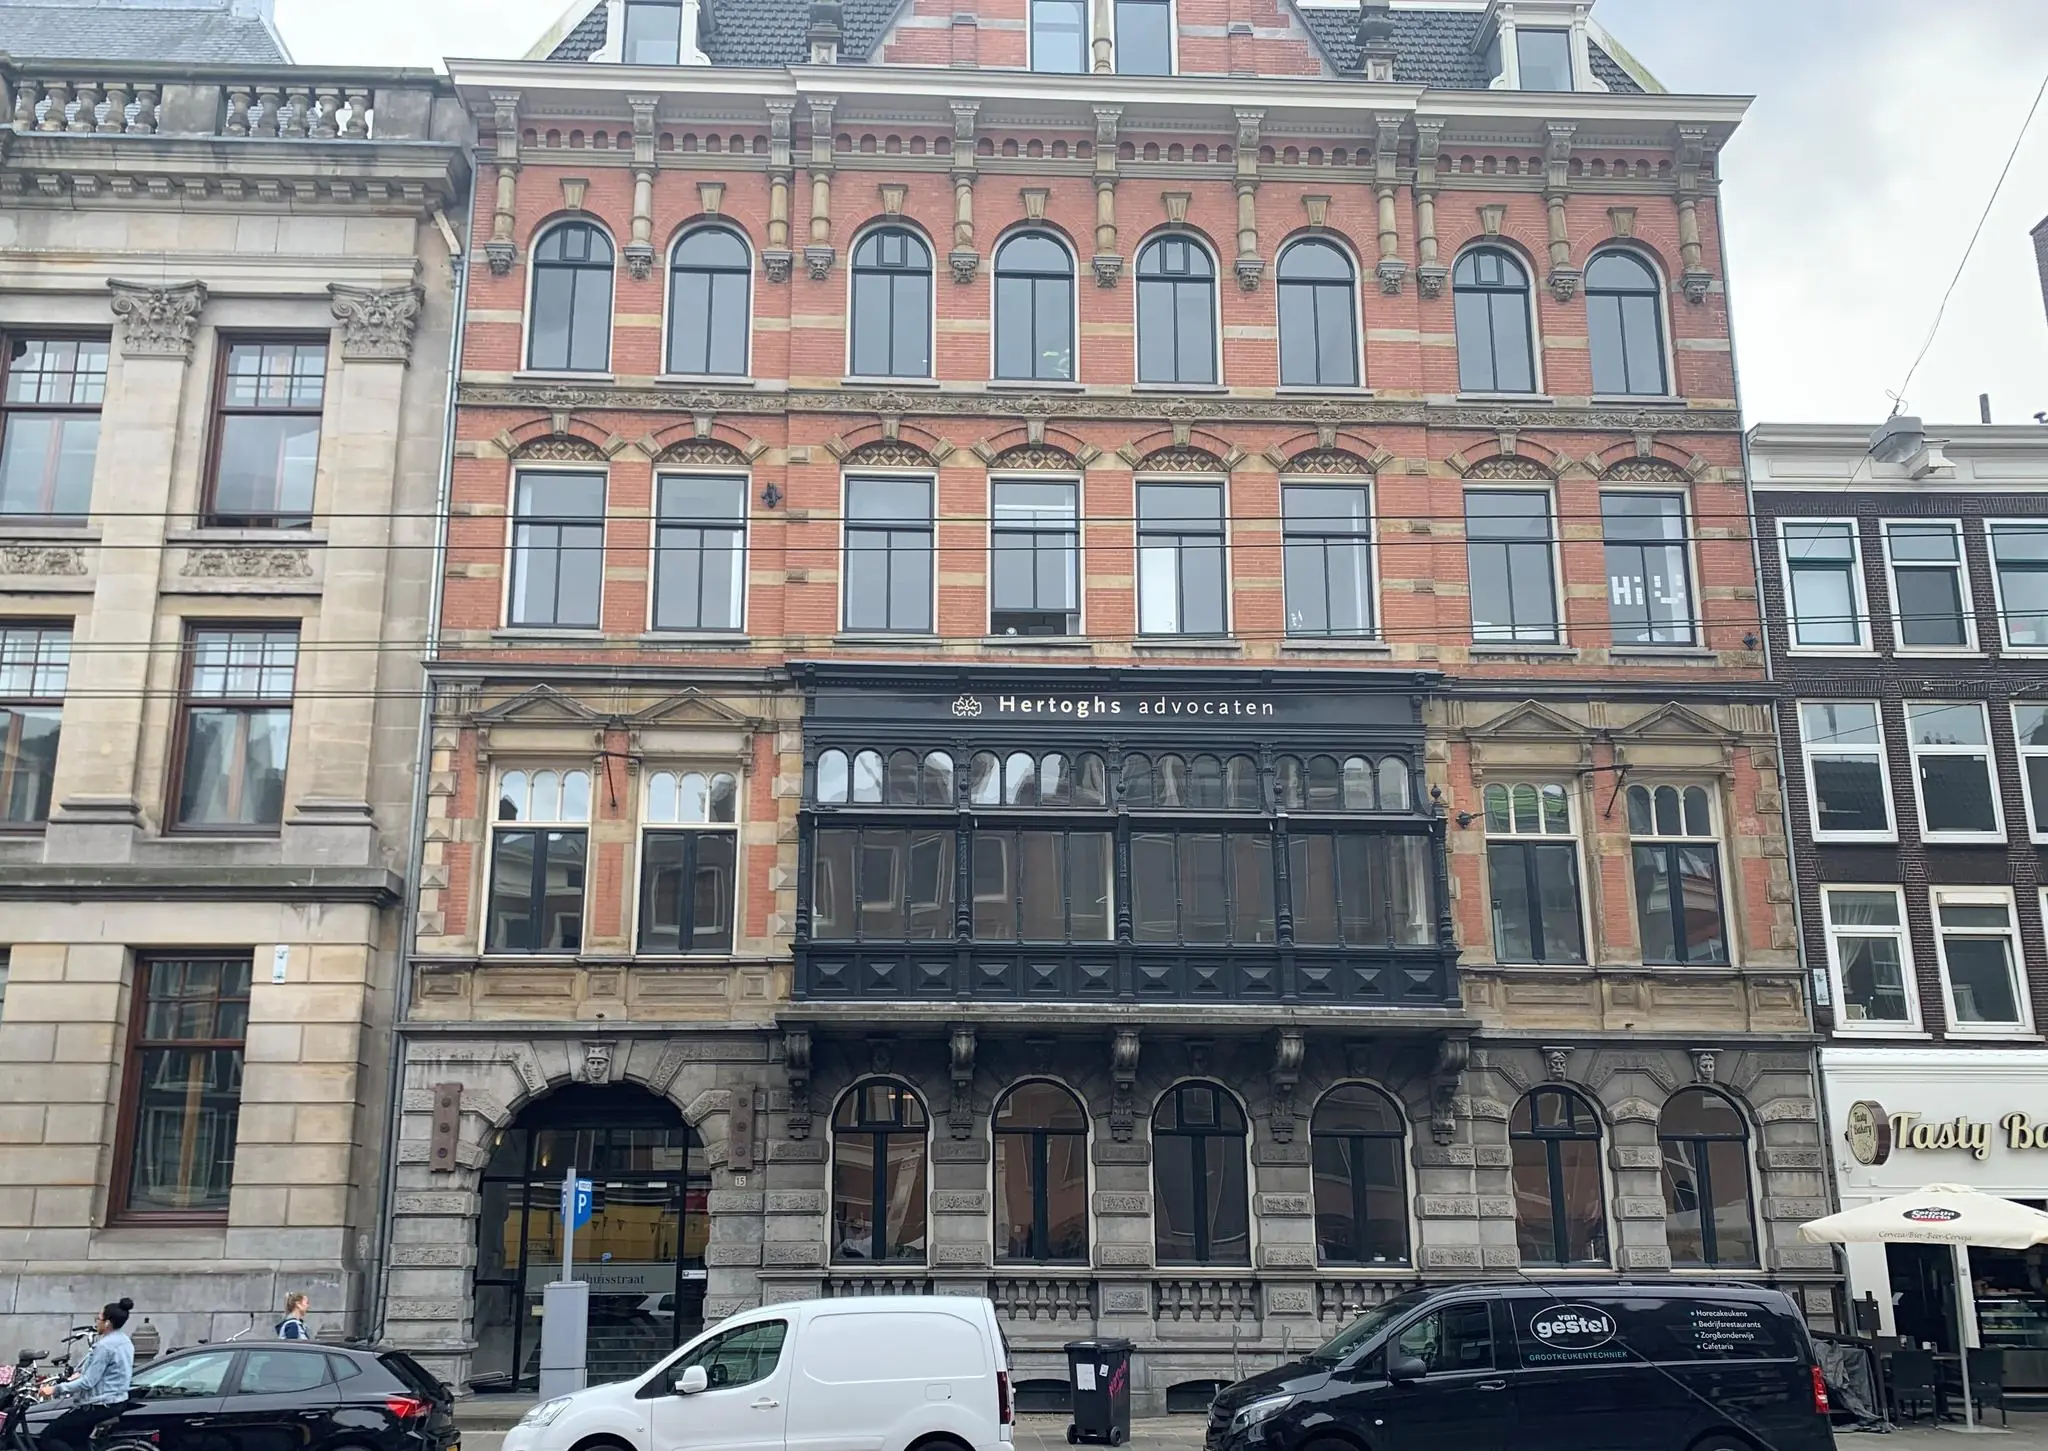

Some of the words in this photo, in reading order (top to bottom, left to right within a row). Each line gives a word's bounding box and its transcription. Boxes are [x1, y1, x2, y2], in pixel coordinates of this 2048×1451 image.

[1611, 576, 1643, 605] Hi
[999, 696, 1121, 718] Hertoghs
[1138, 697, 1273, 715] advocaten
[1888, 1111, 1992, 1160] Tasty
[578, 1193, 587, 1214] P
[1536, 1316, 1609, 1338] gestel
[1698, 1320, 1761, 1329] Bedrijfsrestaurants
[1529, 1351, 1628, 1361] GROOTKEUKENTECHNIEK
[1702, 1342, 1734, 1350] Cafetaria
